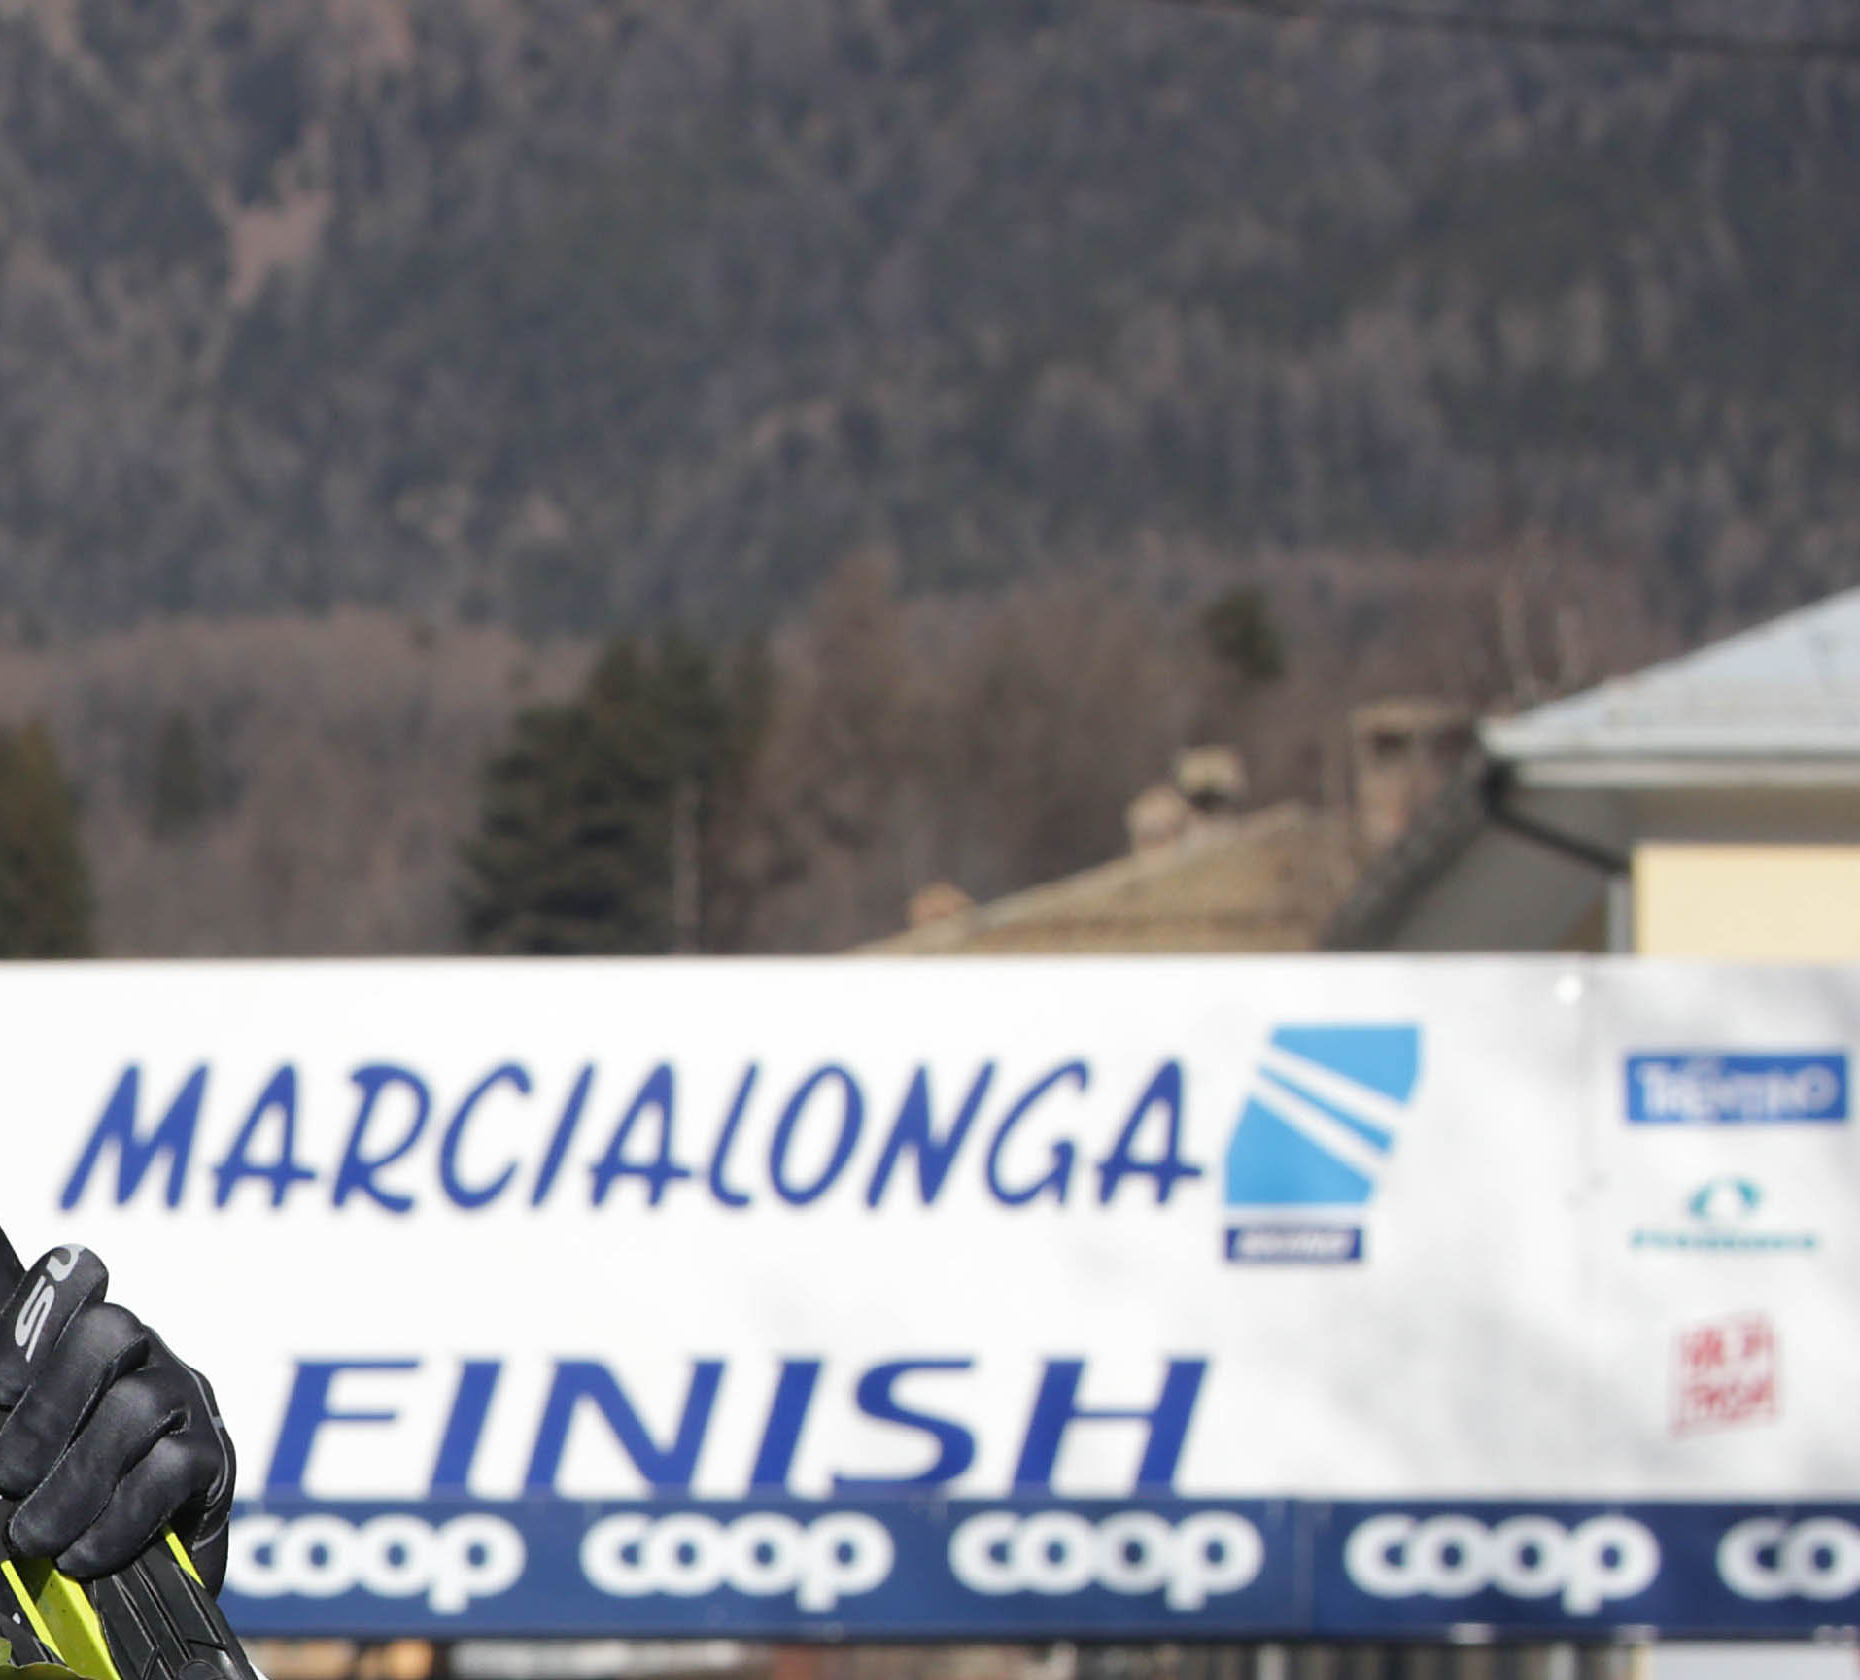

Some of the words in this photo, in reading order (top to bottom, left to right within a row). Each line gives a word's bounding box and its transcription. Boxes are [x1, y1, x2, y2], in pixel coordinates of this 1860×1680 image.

[59, 1057, 1202, 1214] MARCIALONGA
[262, 1357, 1209, 1497] FINISH
[227, 1513, 525, 1613] coop
[581, 1512, 893, 1612] coop
[948, 1510, 1262, 1611] coop
[1344, 1514, 1661, 1614] coop
